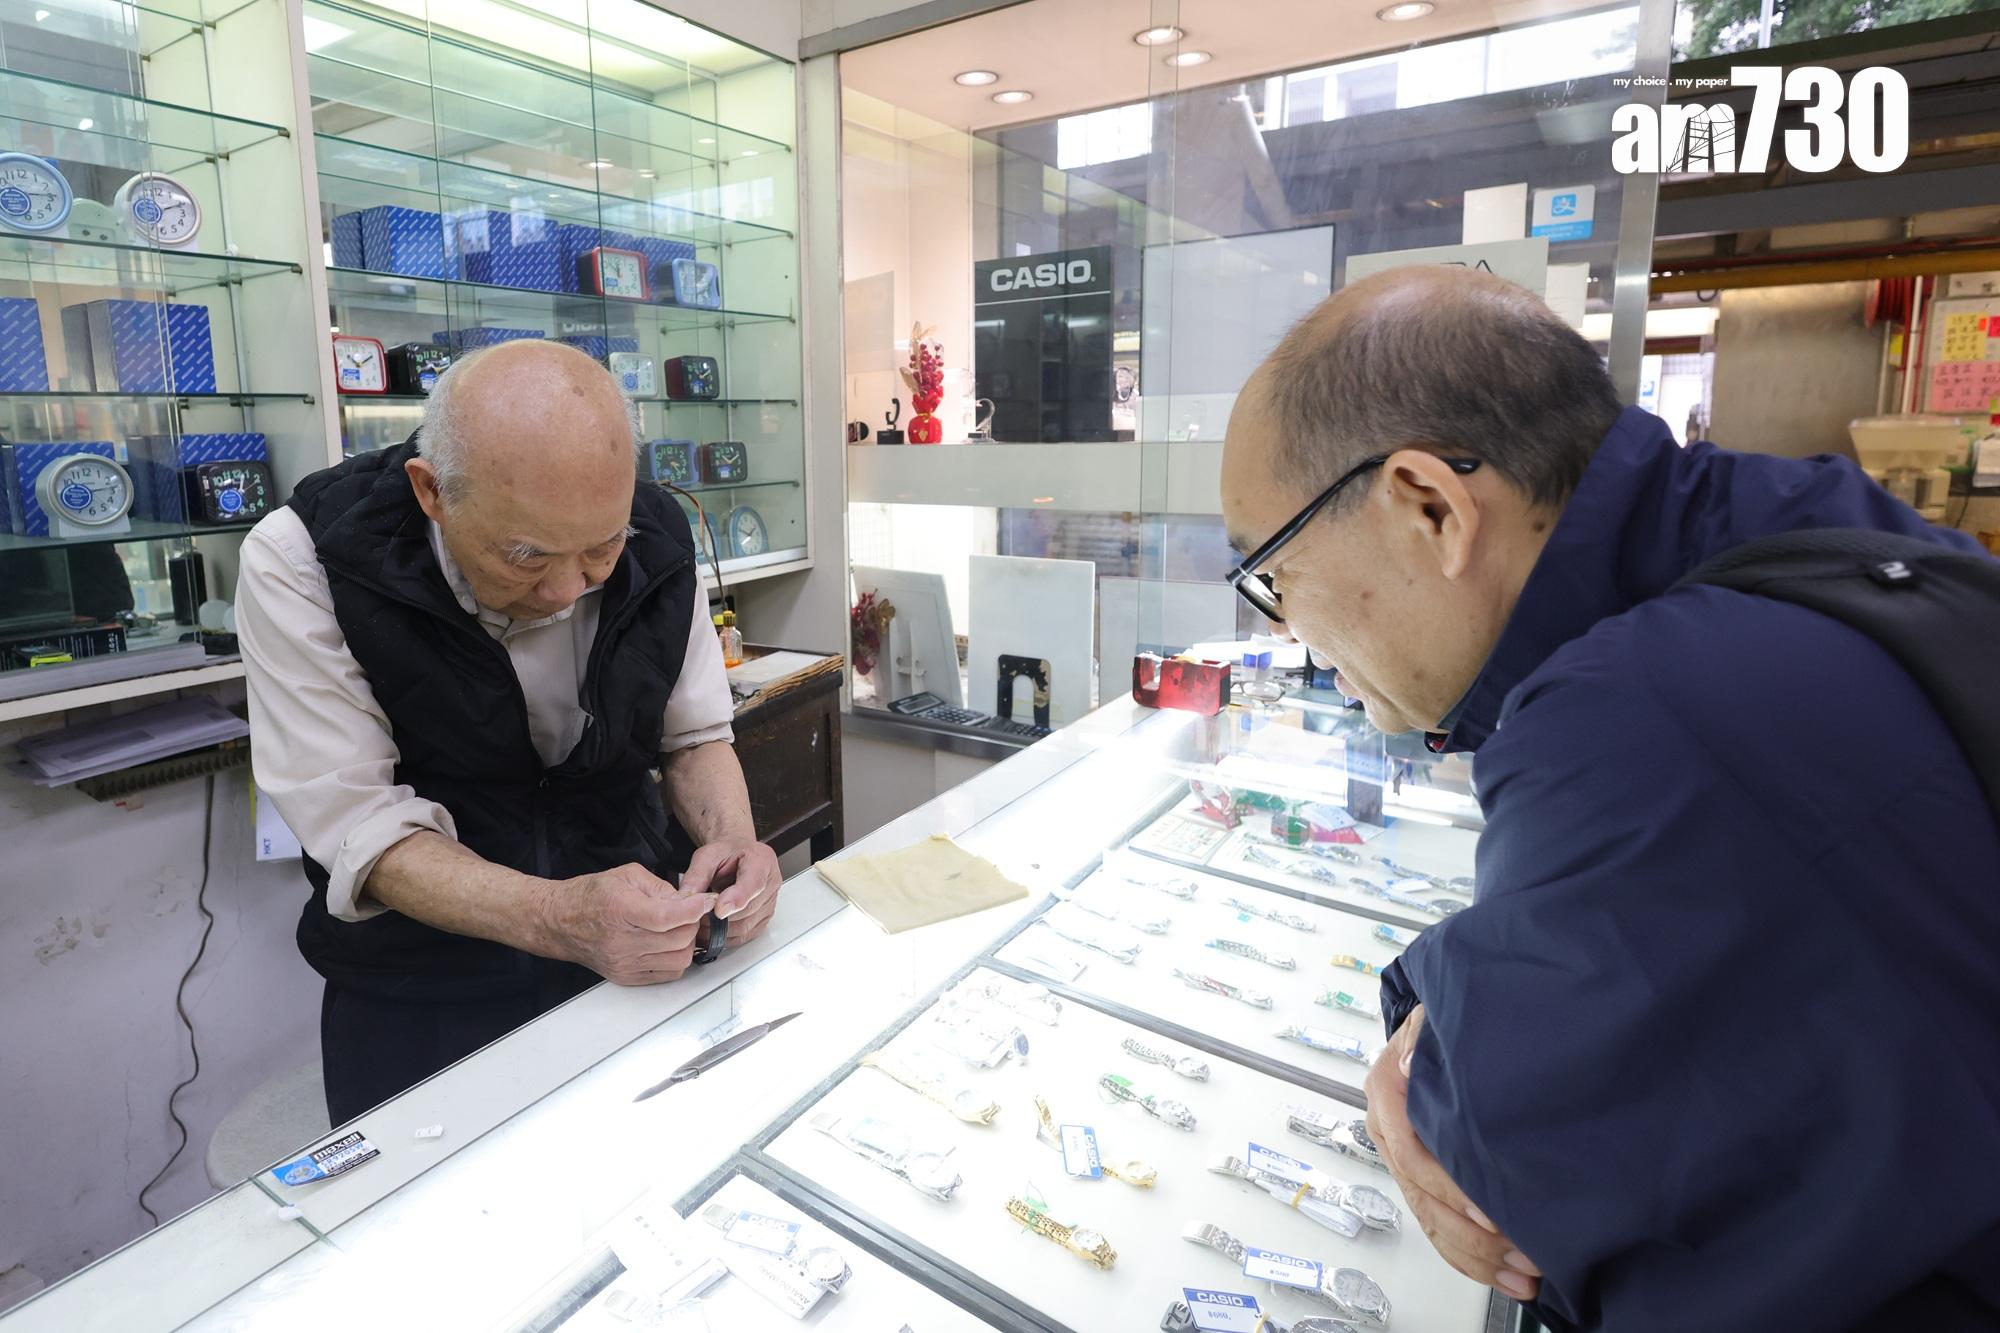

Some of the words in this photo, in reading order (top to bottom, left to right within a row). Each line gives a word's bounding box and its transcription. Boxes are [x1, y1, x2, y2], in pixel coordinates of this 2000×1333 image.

[5, 170, 14, 180] 11
[17, 169, 28, 179] 12
[45, 203, 52, 212] 4
[37, 209, 45, 219] 5
[177, 218, 185, 227] 4
[160, 226, 168, 235] 6
[171, 224, 178, 233] 5
[990, 260, 1092, 292] CASIO
[71, 471, 80, 480] 11
[82, 468, 92, 477] 12
[222, 470, 231, 480] 11
[212, 475, 224, 487] 10
[253, 473, 261, 483] 2
[256, 485, 264, 496] 3
[107, 496, 114, 504] 4
[256, 498, 265, 508] 4
[89, 506, 97, 516] 6
[100, 502, 107, 512] 5
[249, 502, 257, 513] 5
[313, 1132, 361, 1161] maxell
[1086, 1134, 1098, 1167] CASIO
[1260, 1251, 1307, 1268] CASIO
[1197, 1292, 1243, 1307] CASIO
